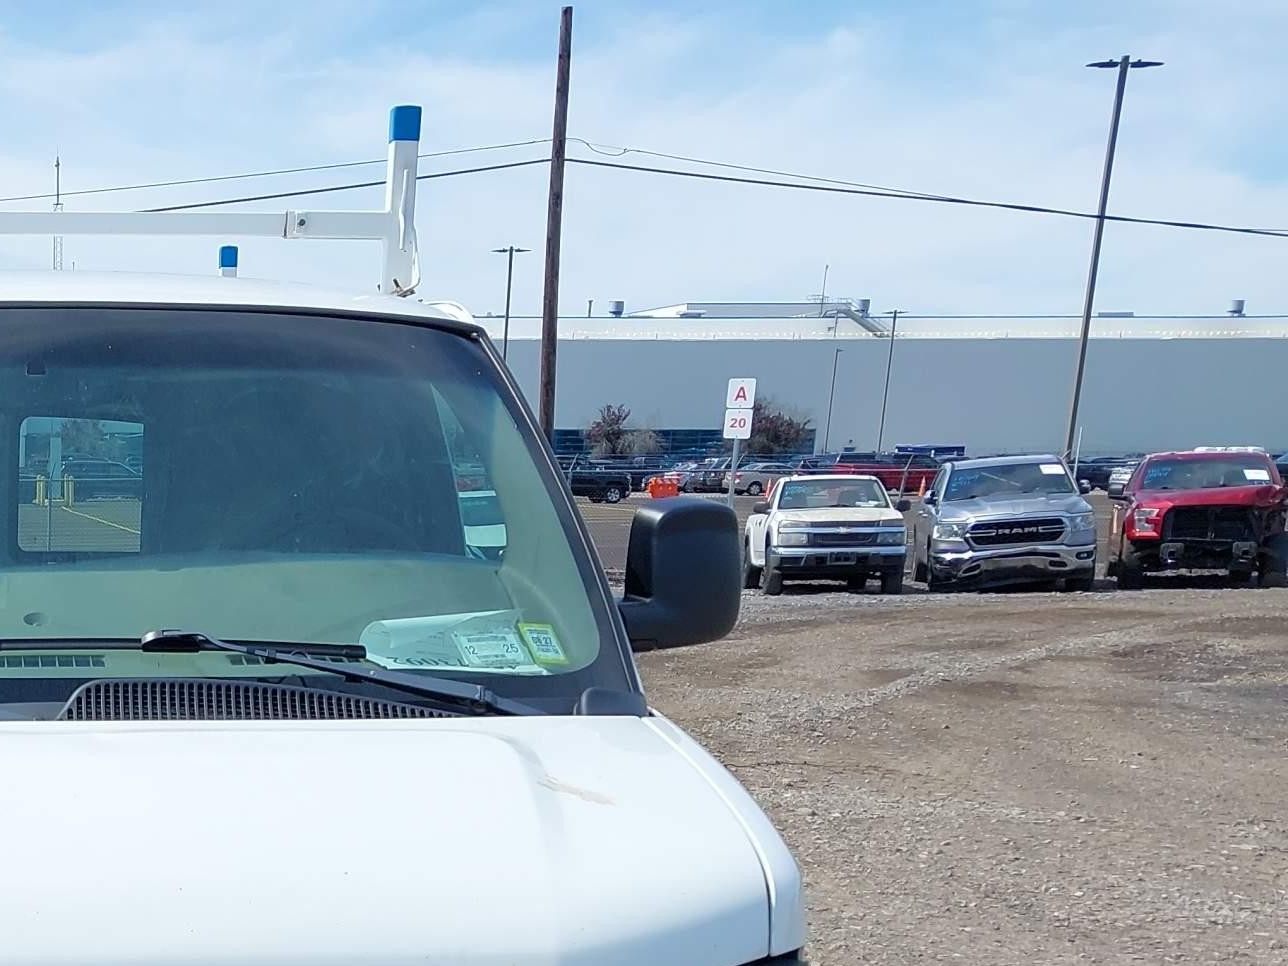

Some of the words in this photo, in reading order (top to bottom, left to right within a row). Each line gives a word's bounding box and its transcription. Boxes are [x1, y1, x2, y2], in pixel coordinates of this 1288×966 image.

[734, 386, 747, 402] A
[729, 418, 746, 429] 20
[999, 526, 1037, 534] RAM
[465, 645, 478, 655] 12
[503, 643, 519, 653] 25
